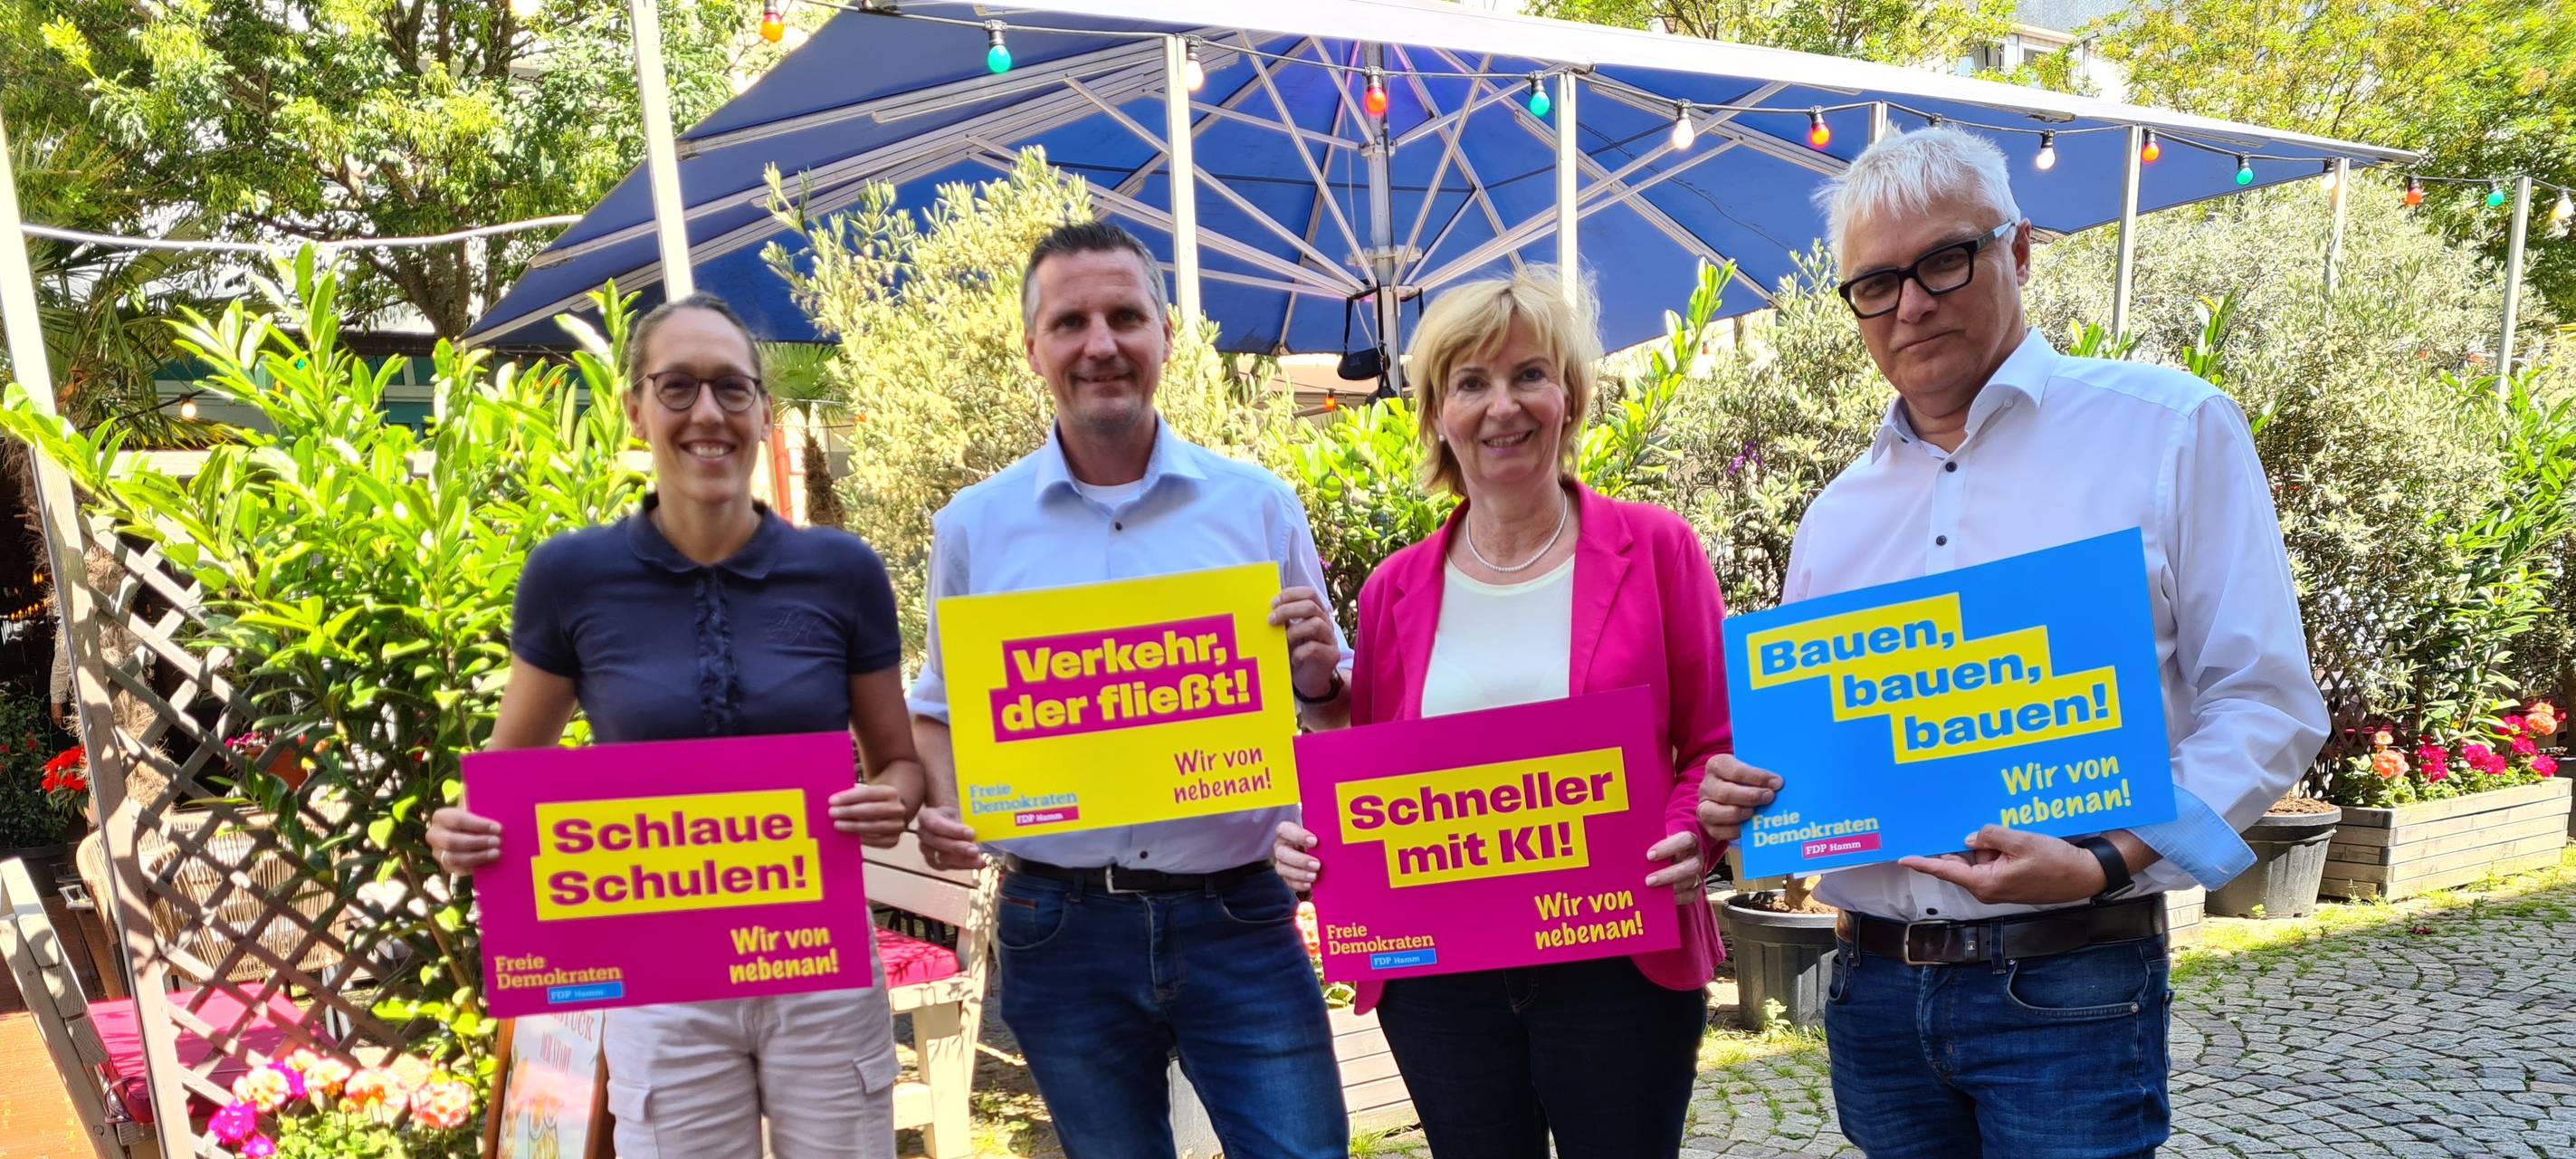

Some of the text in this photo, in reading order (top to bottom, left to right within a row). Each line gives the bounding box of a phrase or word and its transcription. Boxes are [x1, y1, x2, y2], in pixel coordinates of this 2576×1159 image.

[1011, 630, 1228, 684] Verkehr,
[1760, 618, 1955, 676] Bauen,
[1842, 652, 2042, 709] bauen,
[1000, 669, 1251, 732] der fließt!
[1903, 683, 2110, 752] bauen!
[1174, 746, 1264, 776] Wir von
[2000, 755, 2120, 796] Wir von
[969, 782, 1011, 798] Freie
[1173, 767, 1273, 804] nebenan!
[1349, 771, 1614, 829] Schneller
[971, 793, 1078, 815] Demokraten
[1752, 810, 1800, 830] Freie
[2000, 779, 2132, 828] nebenan!
[551, 811, 793, 854] Schlaue
[1397, 821, 1574, 876] mit KI!
[1753, 818, 1880, 848] Demokraten
[1806, 841, 1861, 855] FDP Hamm
[547, 855, 807, 906] Schulen!
[1535, 889, 1634, 921] Wir von
[730, 925, 830, 955] Wir von
[1326, 922, 1368, 940] Freie
[1329, 934, 1435, 955] Demokraten
[1535, 910, 1644, 950] nebenan!
[494, 953, 546, 972] Freie
[729, 948, 839, 984] nebenan!
[1374, 955, 1420, 966] FDP Hamm
[496, 967, 622, 990] Demokraten
[550, 990, 571, 1001] FDP
